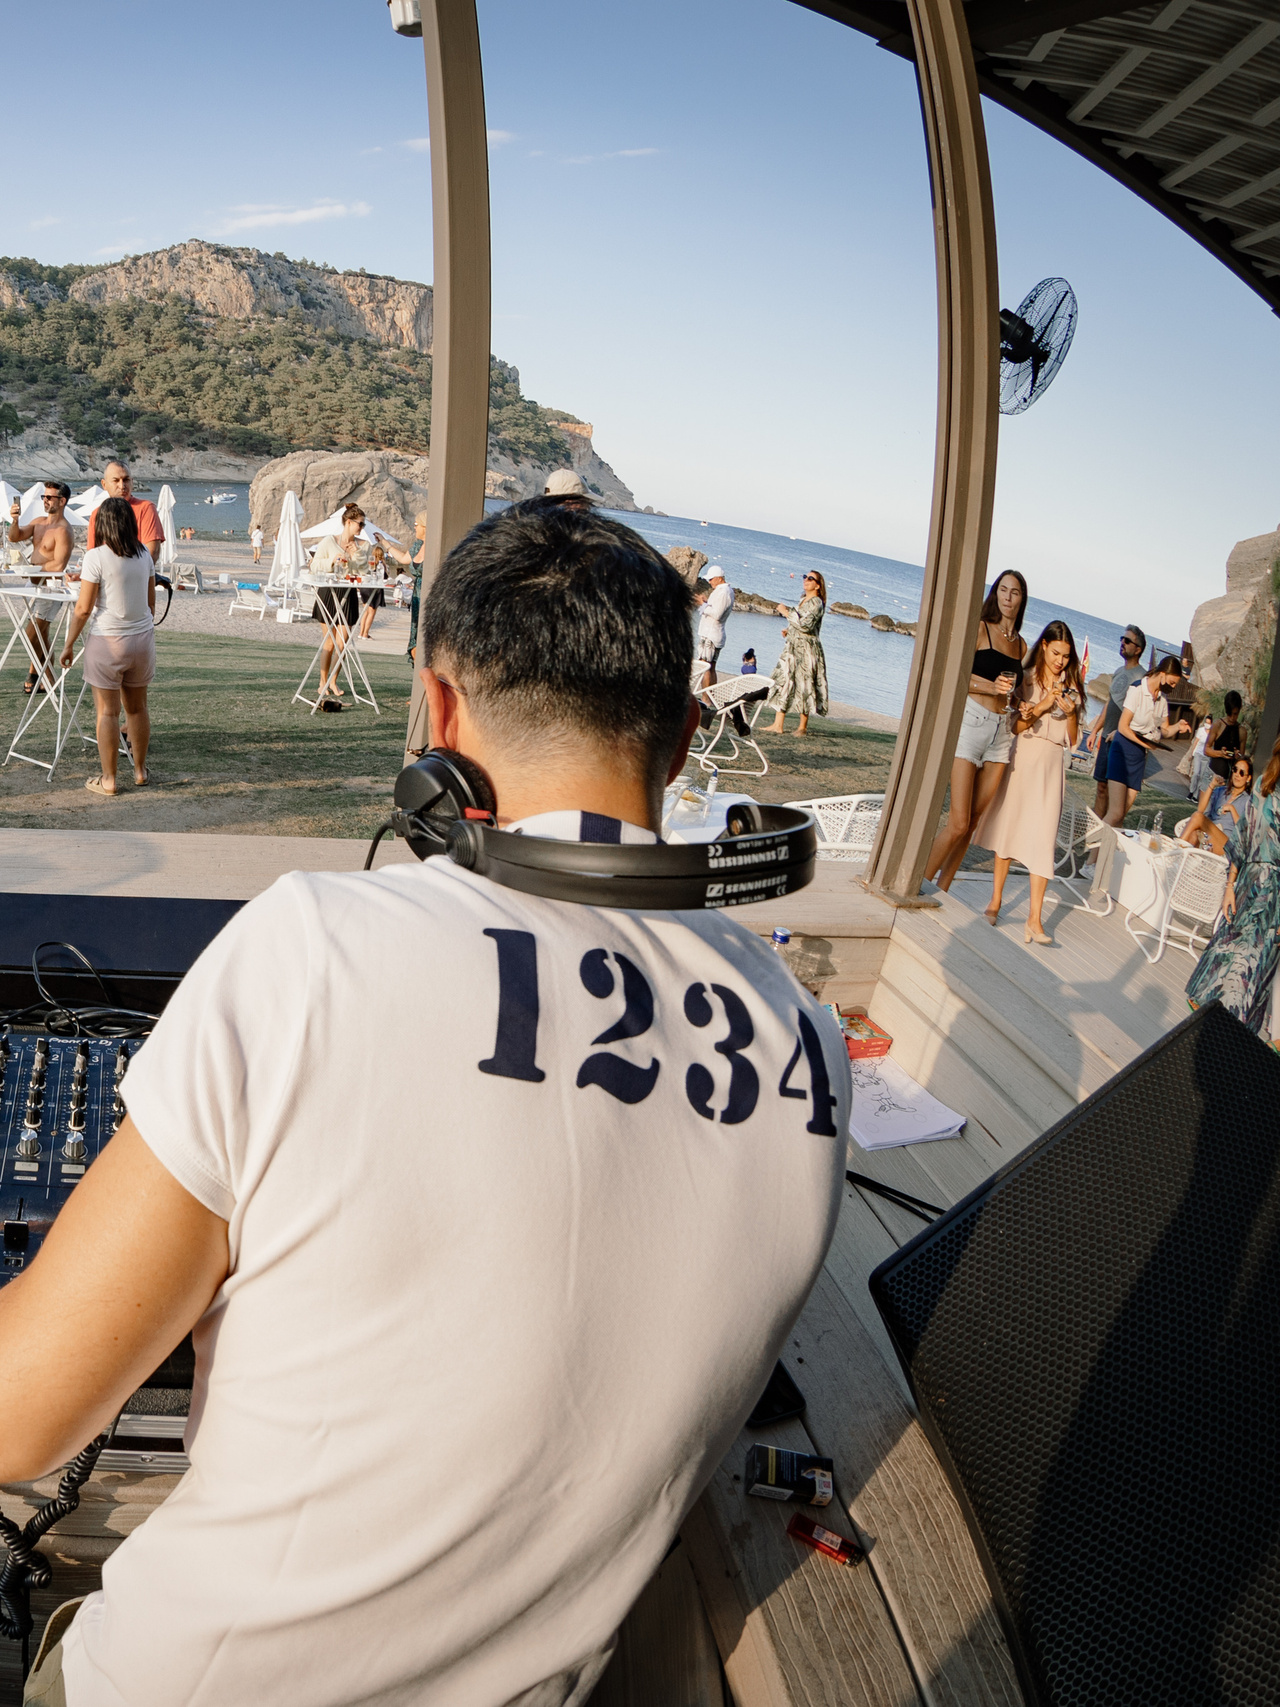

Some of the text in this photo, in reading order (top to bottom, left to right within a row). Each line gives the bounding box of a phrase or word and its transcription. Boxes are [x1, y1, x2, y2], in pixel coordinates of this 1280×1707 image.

[708, 850, 777, 869] SENNHEISER
[725, 874, 788, 894] SENNHEISER
[705, 899, 726, 908] MADE
[738, 894, 766, 904] IRELAND
[477, 928, 838, 1138] 1234
